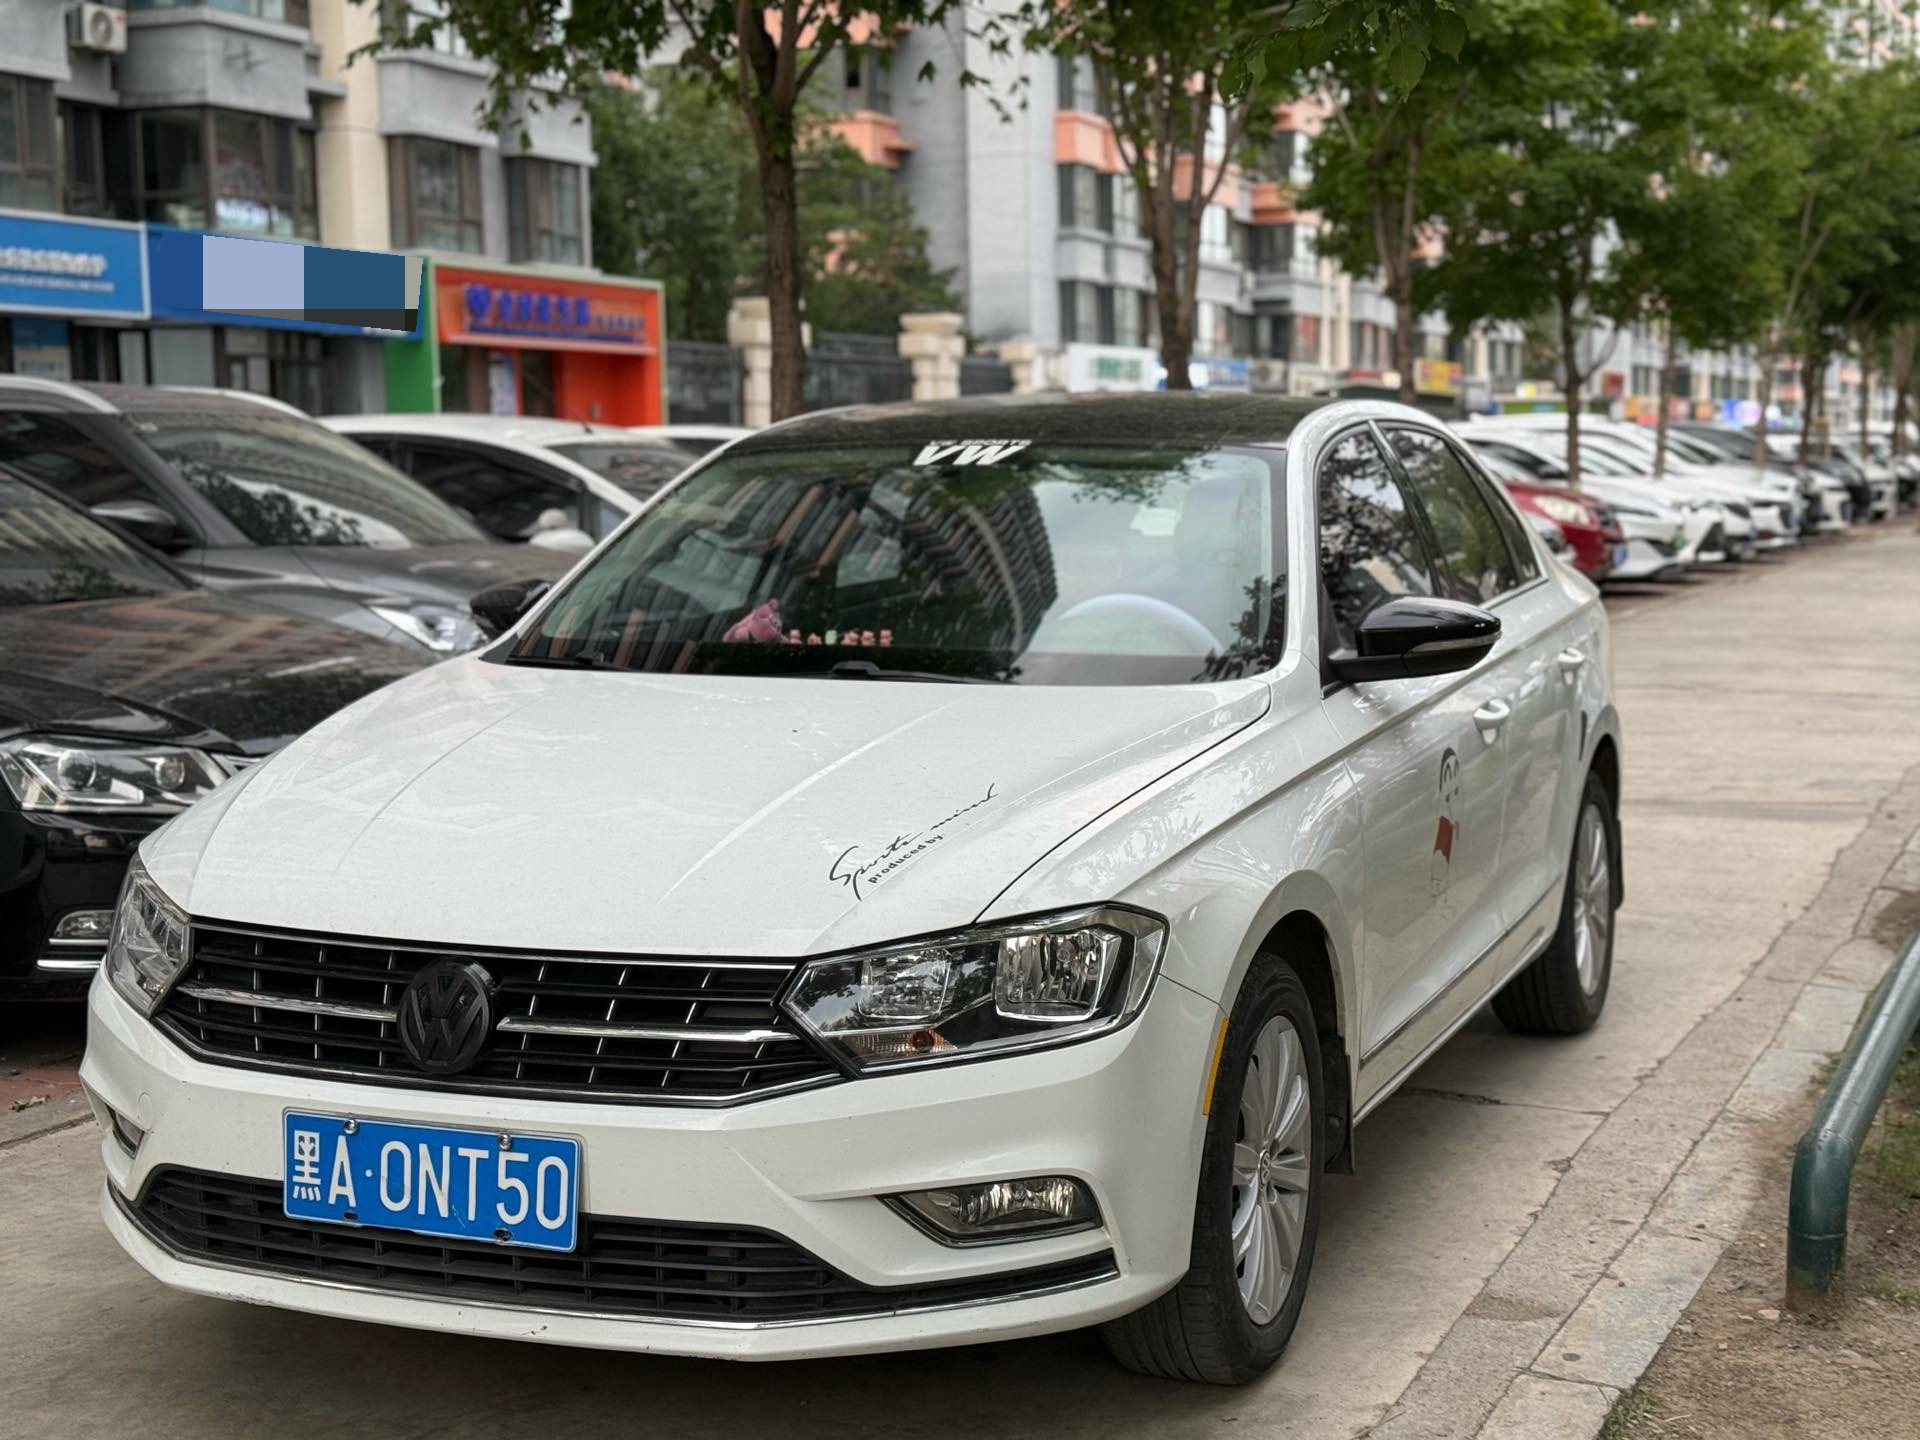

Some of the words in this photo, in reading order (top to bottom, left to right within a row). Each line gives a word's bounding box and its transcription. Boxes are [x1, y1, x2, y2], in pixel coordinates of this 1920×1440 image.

[913, 445, 1026, 466] VW
[868, 843, 927, 884] produced
[924, 833, 944, 846] by
